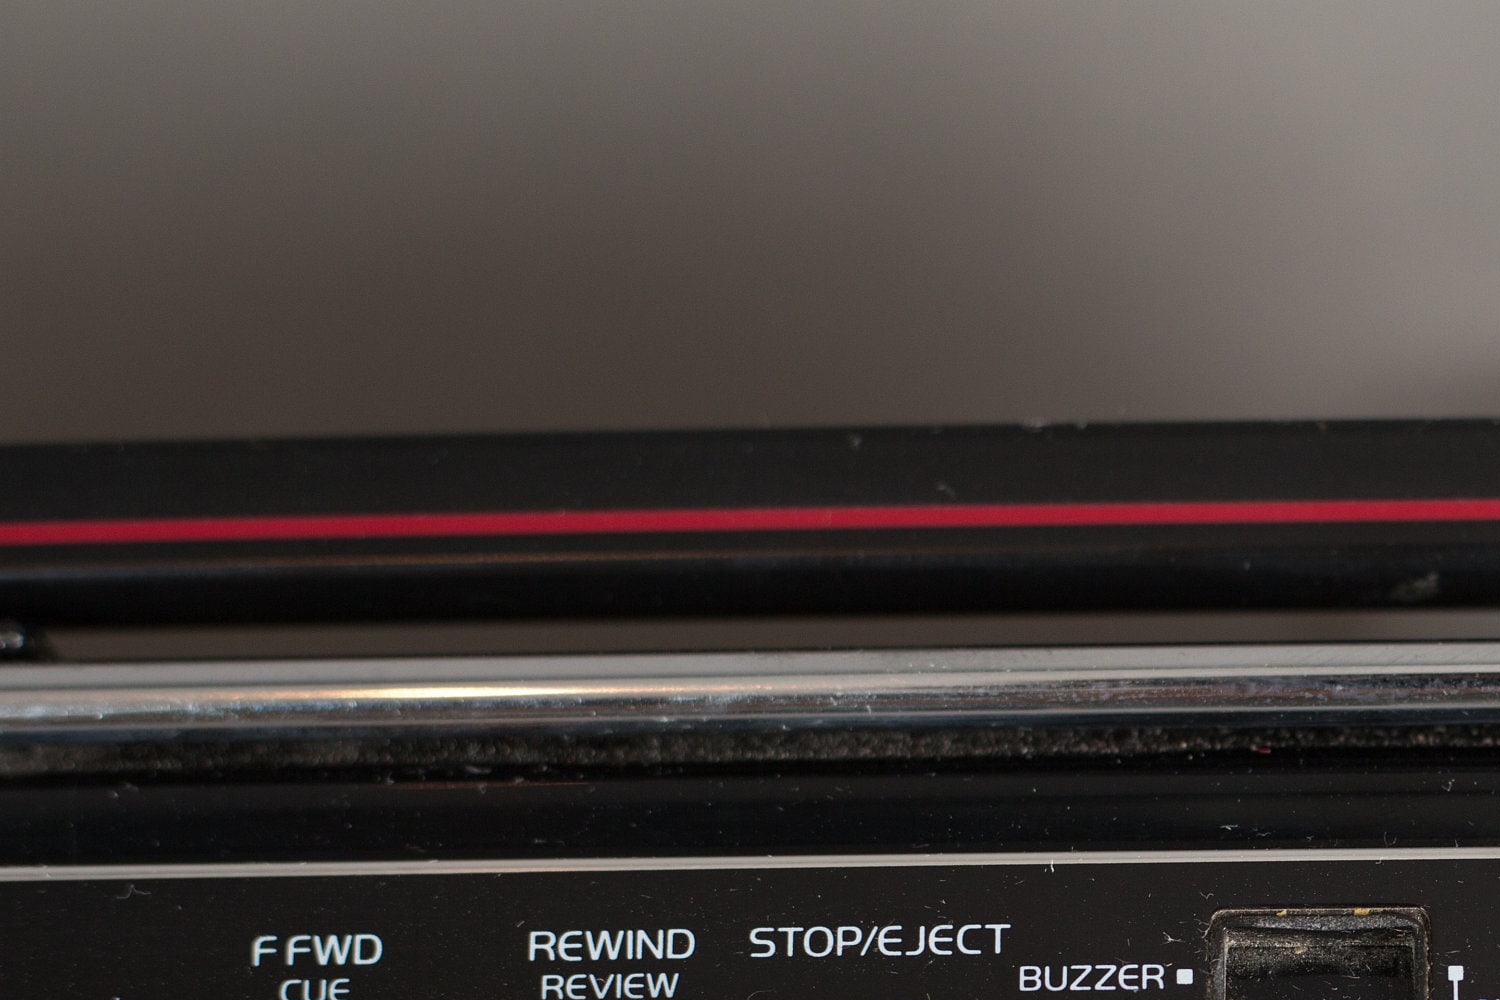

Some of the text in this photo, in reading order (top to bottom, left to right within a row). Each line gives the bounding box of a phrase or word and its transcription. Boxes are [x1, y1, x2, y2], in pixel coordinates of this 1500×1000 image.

[528, 928, 696, 962] REWIND
[749, 923, 1012, 958] STOP/EJECT
[541, 972, 680, 1000] REVIEW
[1019, 963, 1165, 993] BUZZER
